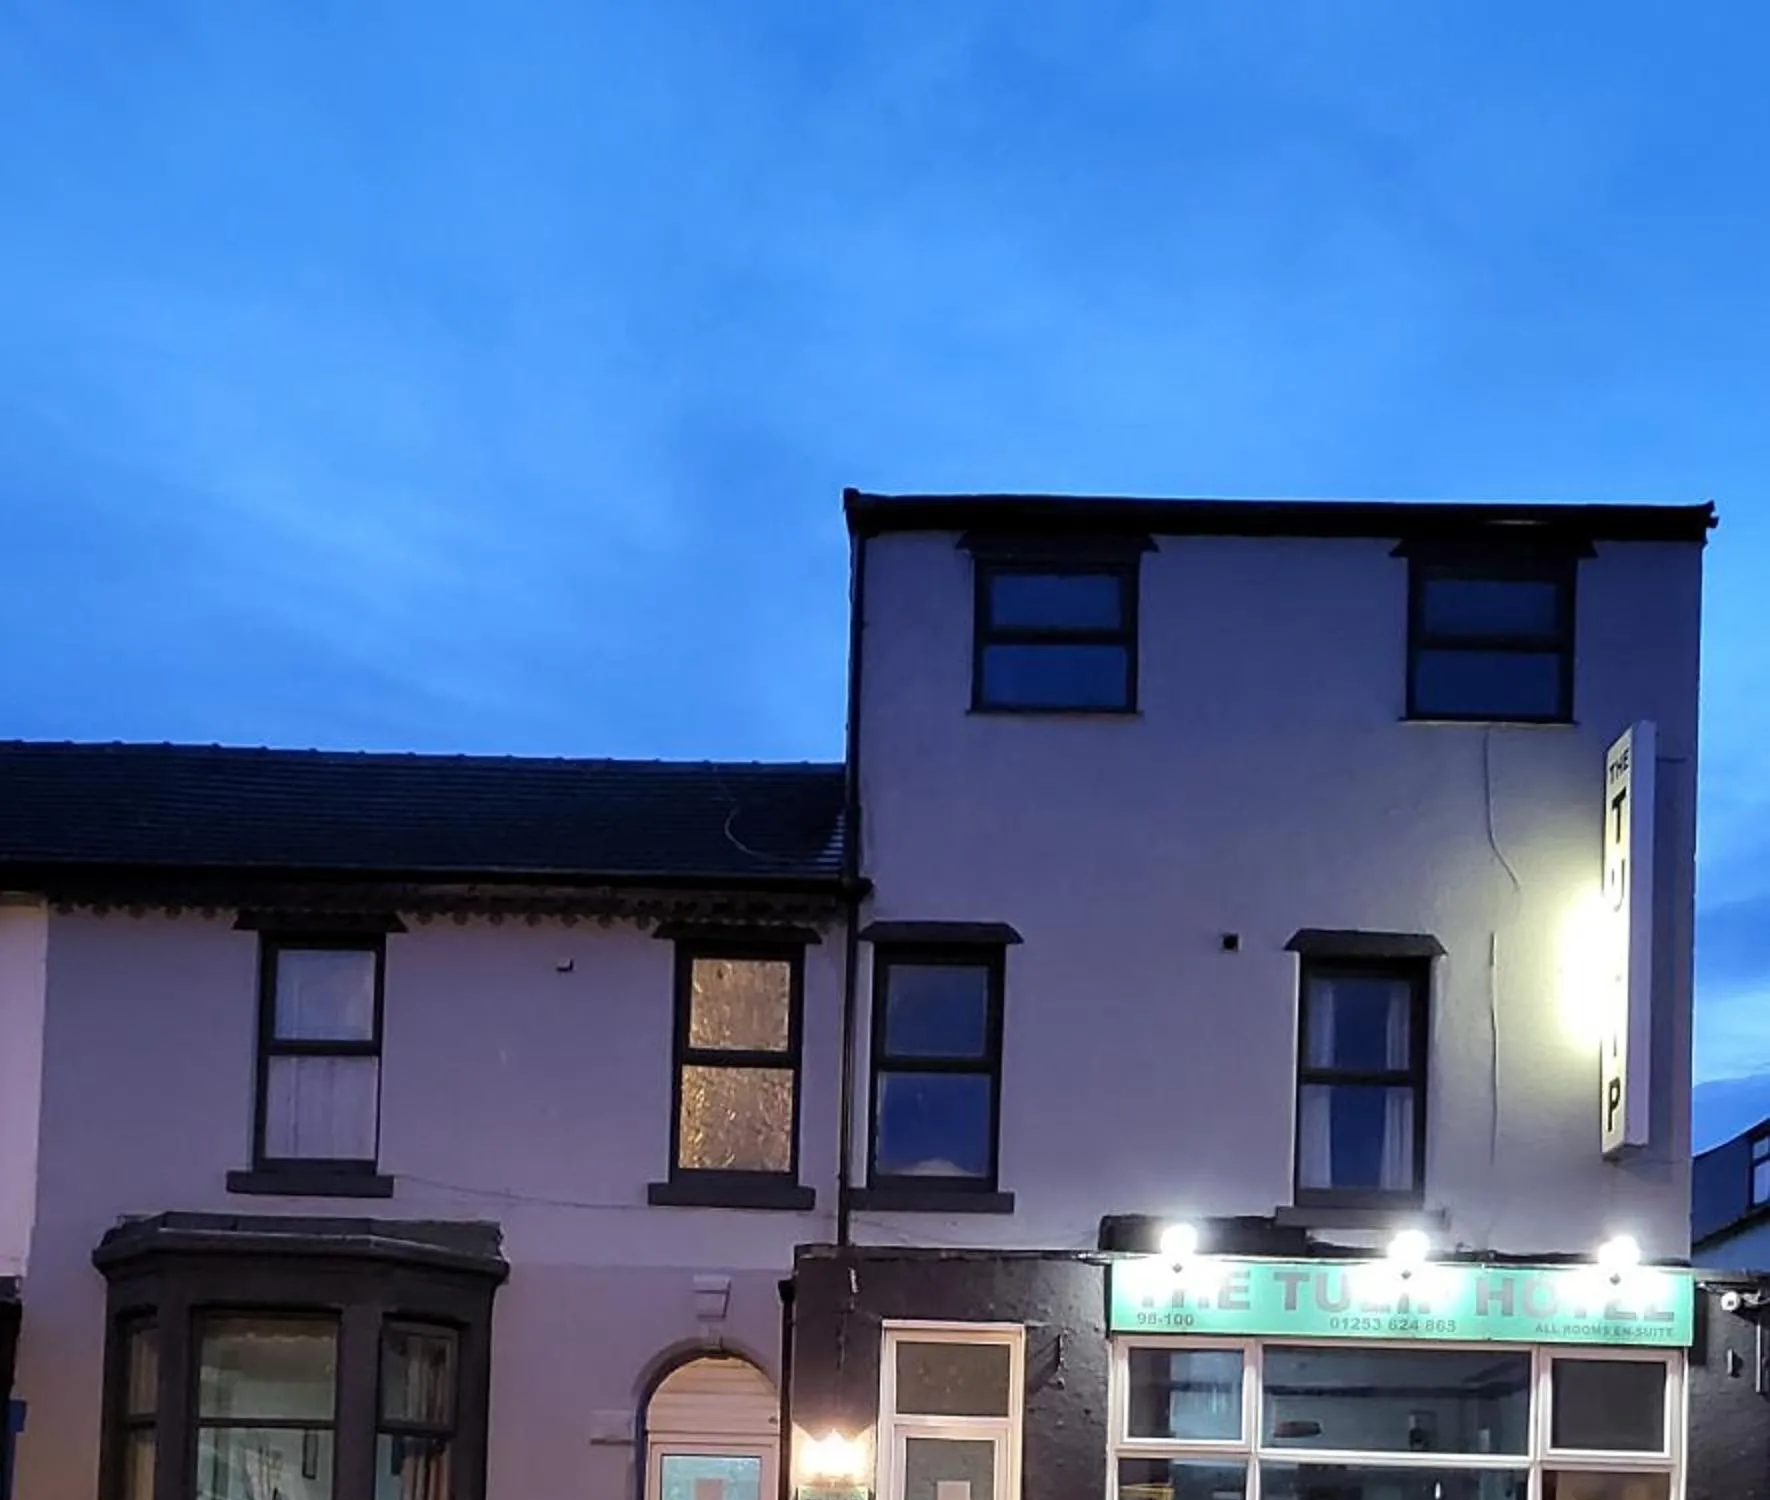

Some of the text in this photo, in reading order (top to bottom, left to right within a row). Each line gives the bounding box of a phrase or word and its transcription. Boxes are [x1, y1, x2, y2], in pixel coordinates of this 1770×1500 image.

[1610, 748, 1629, 784] THE
[1607, 786, 1627, 1132] TUP
[1475, 1277, 1675, 1322] HOEL
[1329, 1317, 1382, 1332] 01253
[1387, 1318, 1419, 1332] 624
[1535, 1323, 1559, 1335] ALL
